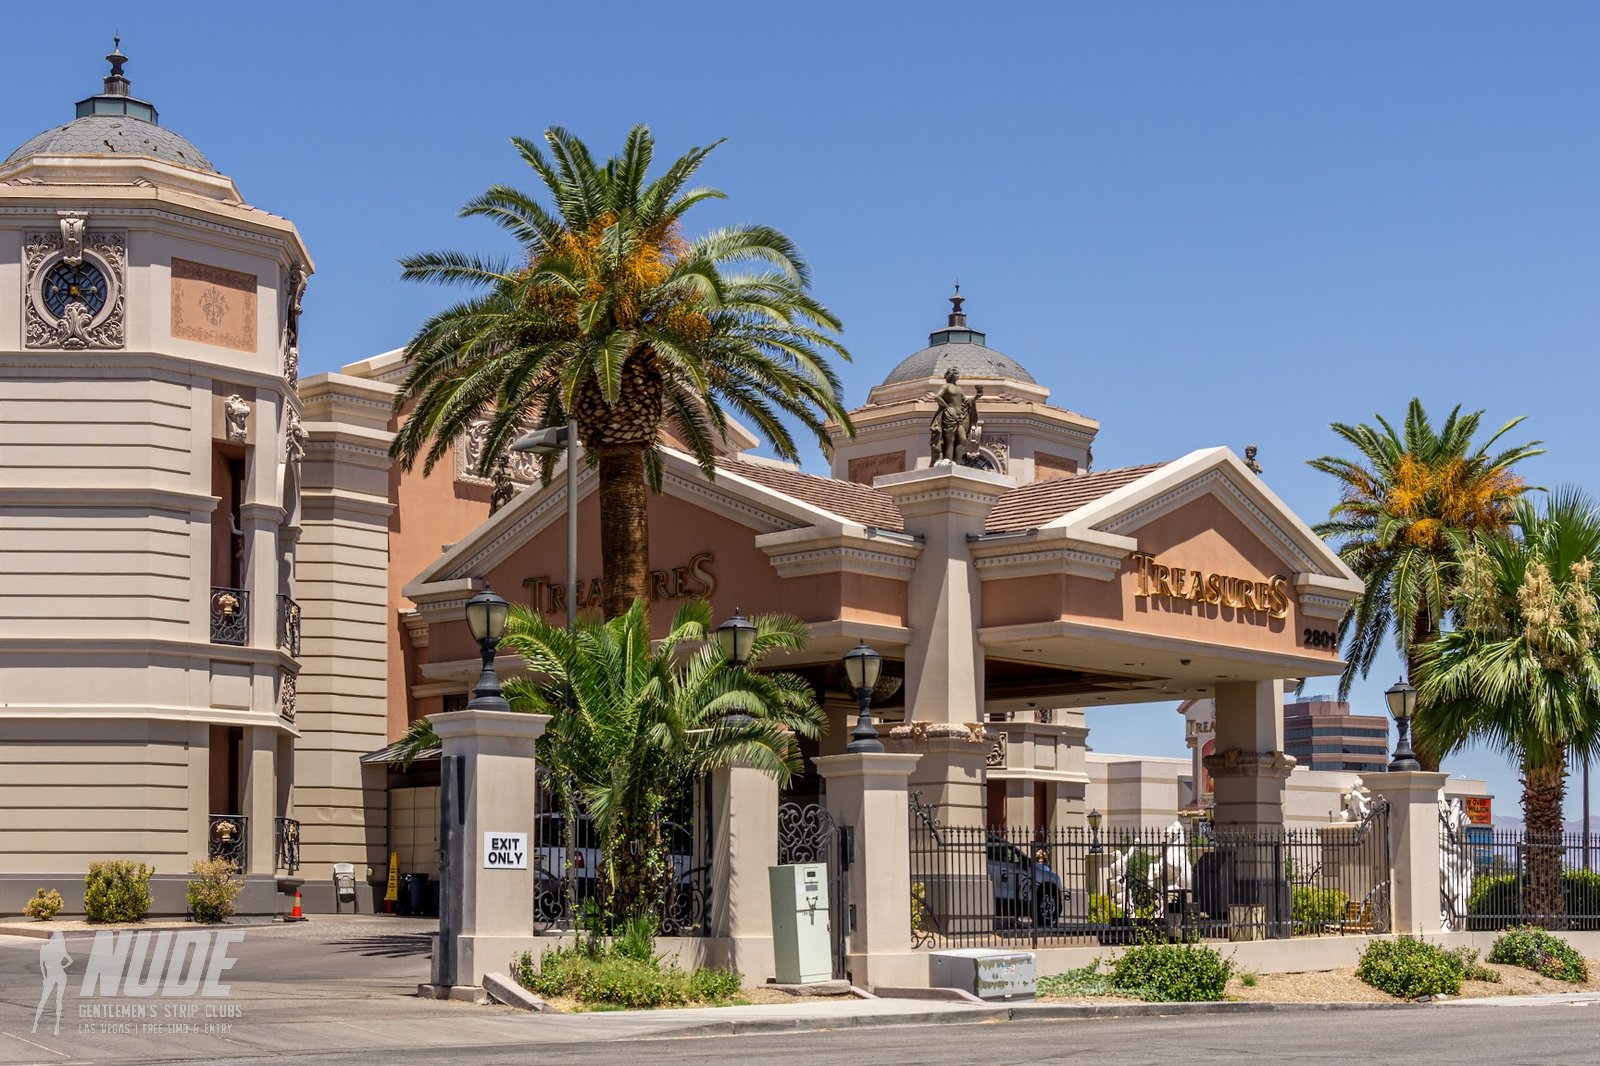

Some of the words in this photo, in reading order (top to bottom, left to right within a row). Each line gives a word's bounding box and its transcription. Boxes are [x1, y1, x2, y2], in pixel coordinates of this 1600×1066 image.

[522, 552, 717, 613] TRARES
[1131, 552, 1289, 619] TREASURES
[1303, 628, 1337, 650] 2801
[491, 837, 520, 851] EXIT
[488, 851, 523, 865] ONLY
